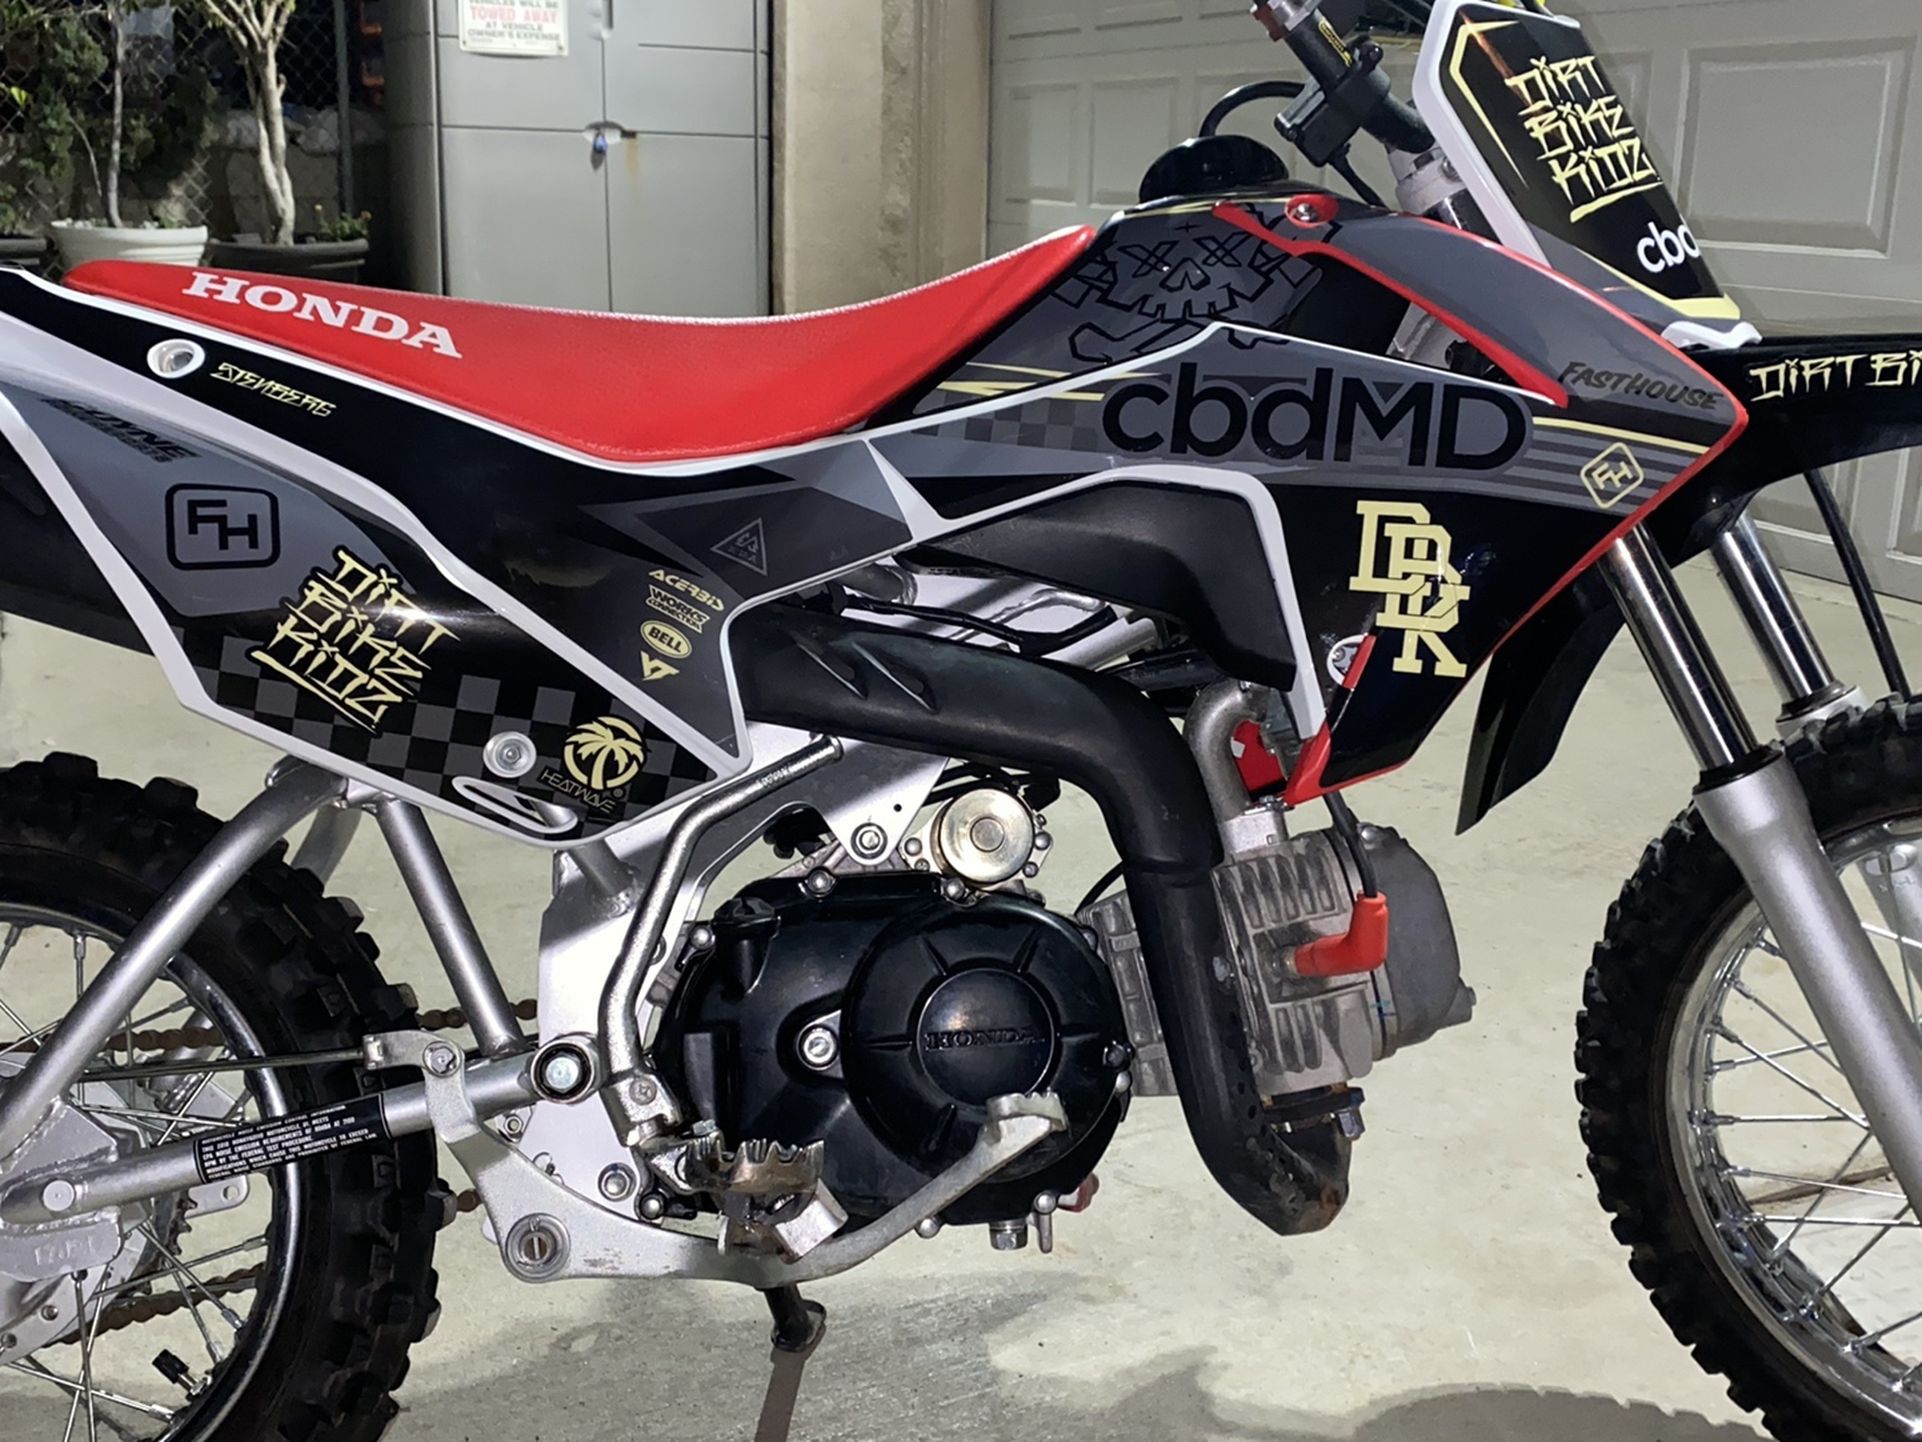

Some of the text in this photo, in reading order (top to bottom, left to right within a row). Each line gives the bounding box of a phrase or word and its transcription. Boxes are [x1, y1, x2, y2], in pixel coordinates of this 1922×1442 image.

[470, 6, 557, 22] TOWED AWAY
[182, 271, 463, 358] HONDA
[1103, 362, 1526, 470] cbdMD
[187, 500, 258, 550] FH
[648, 626, 681, 653] BELL
